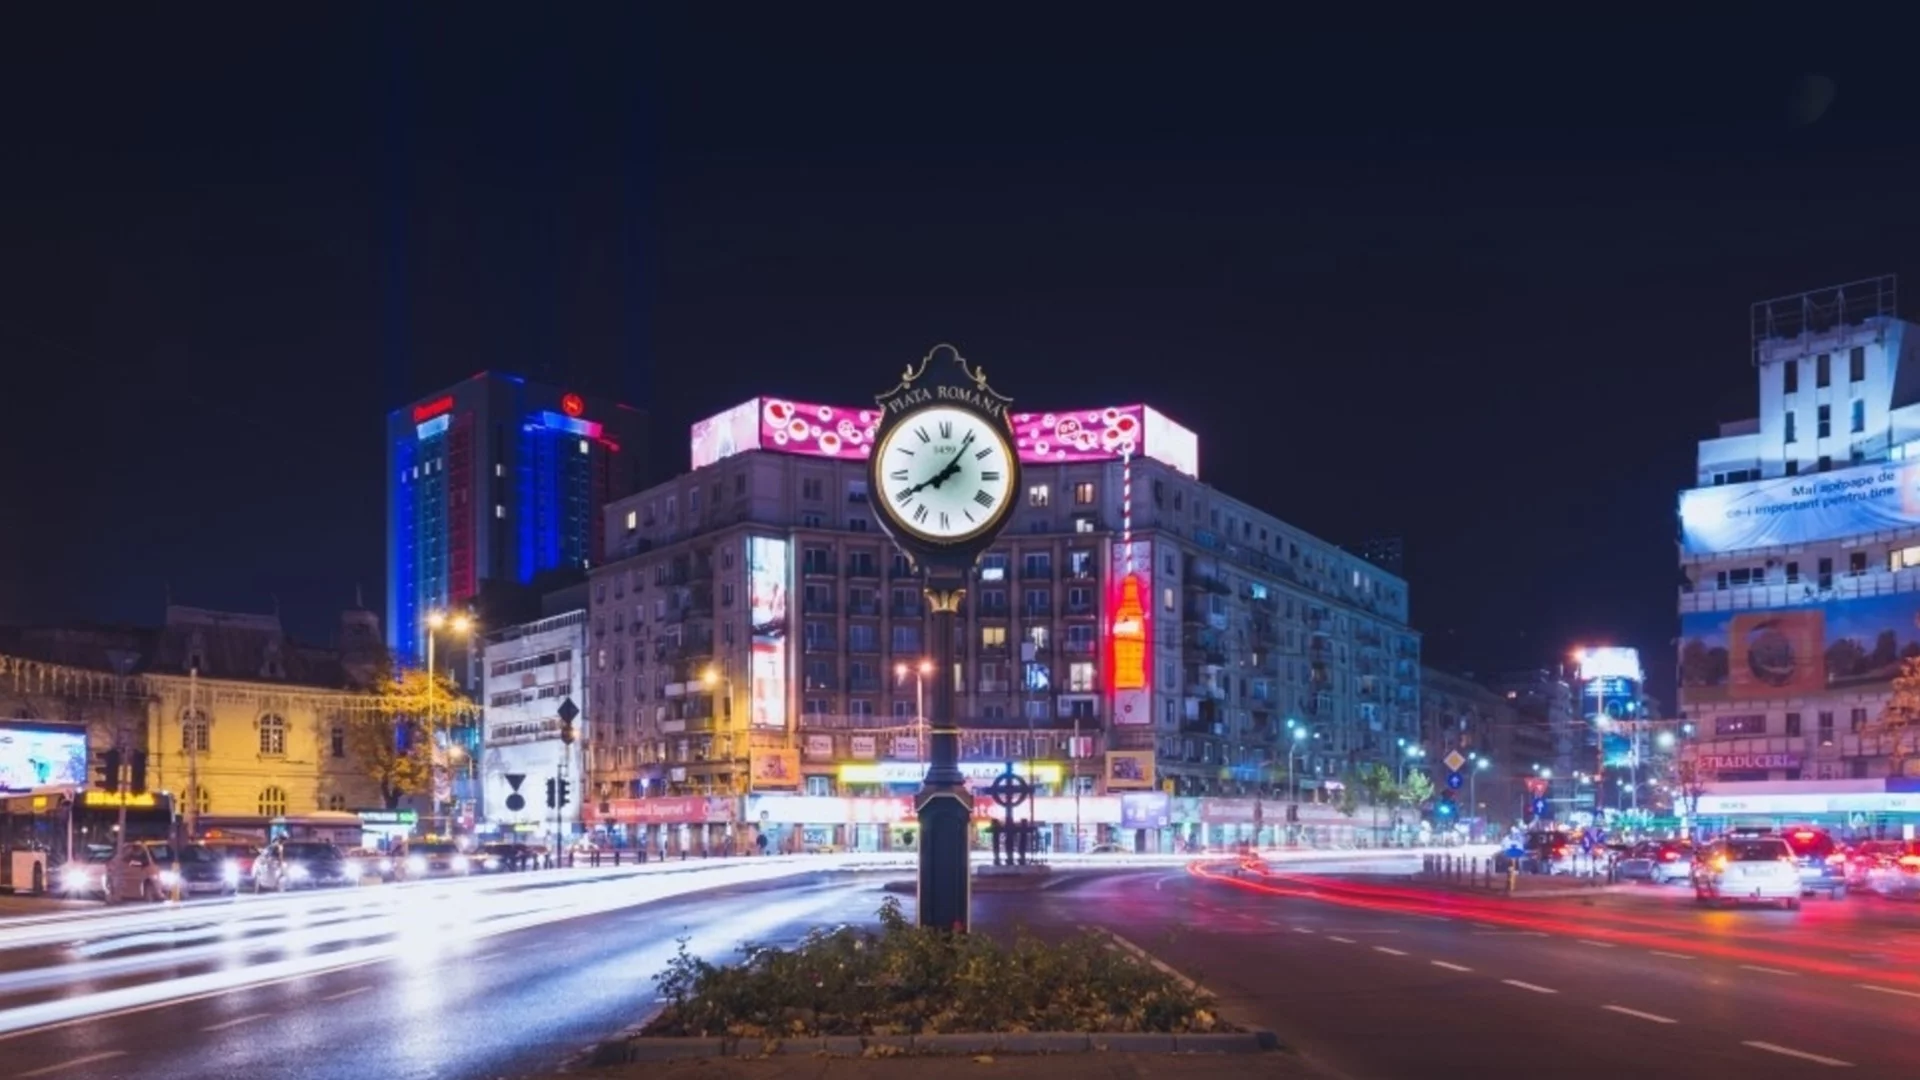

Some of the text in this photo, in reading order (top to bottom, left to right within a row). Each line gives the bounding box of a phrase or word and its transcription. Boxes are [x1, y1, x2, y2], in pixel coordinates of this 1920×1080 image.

[1877, 471, 1895, 483] de
[1755, 498, 1819, 516] important
[1823, 491, 1867, 509] pentru
[1870, 486, 1896, 499] tine
